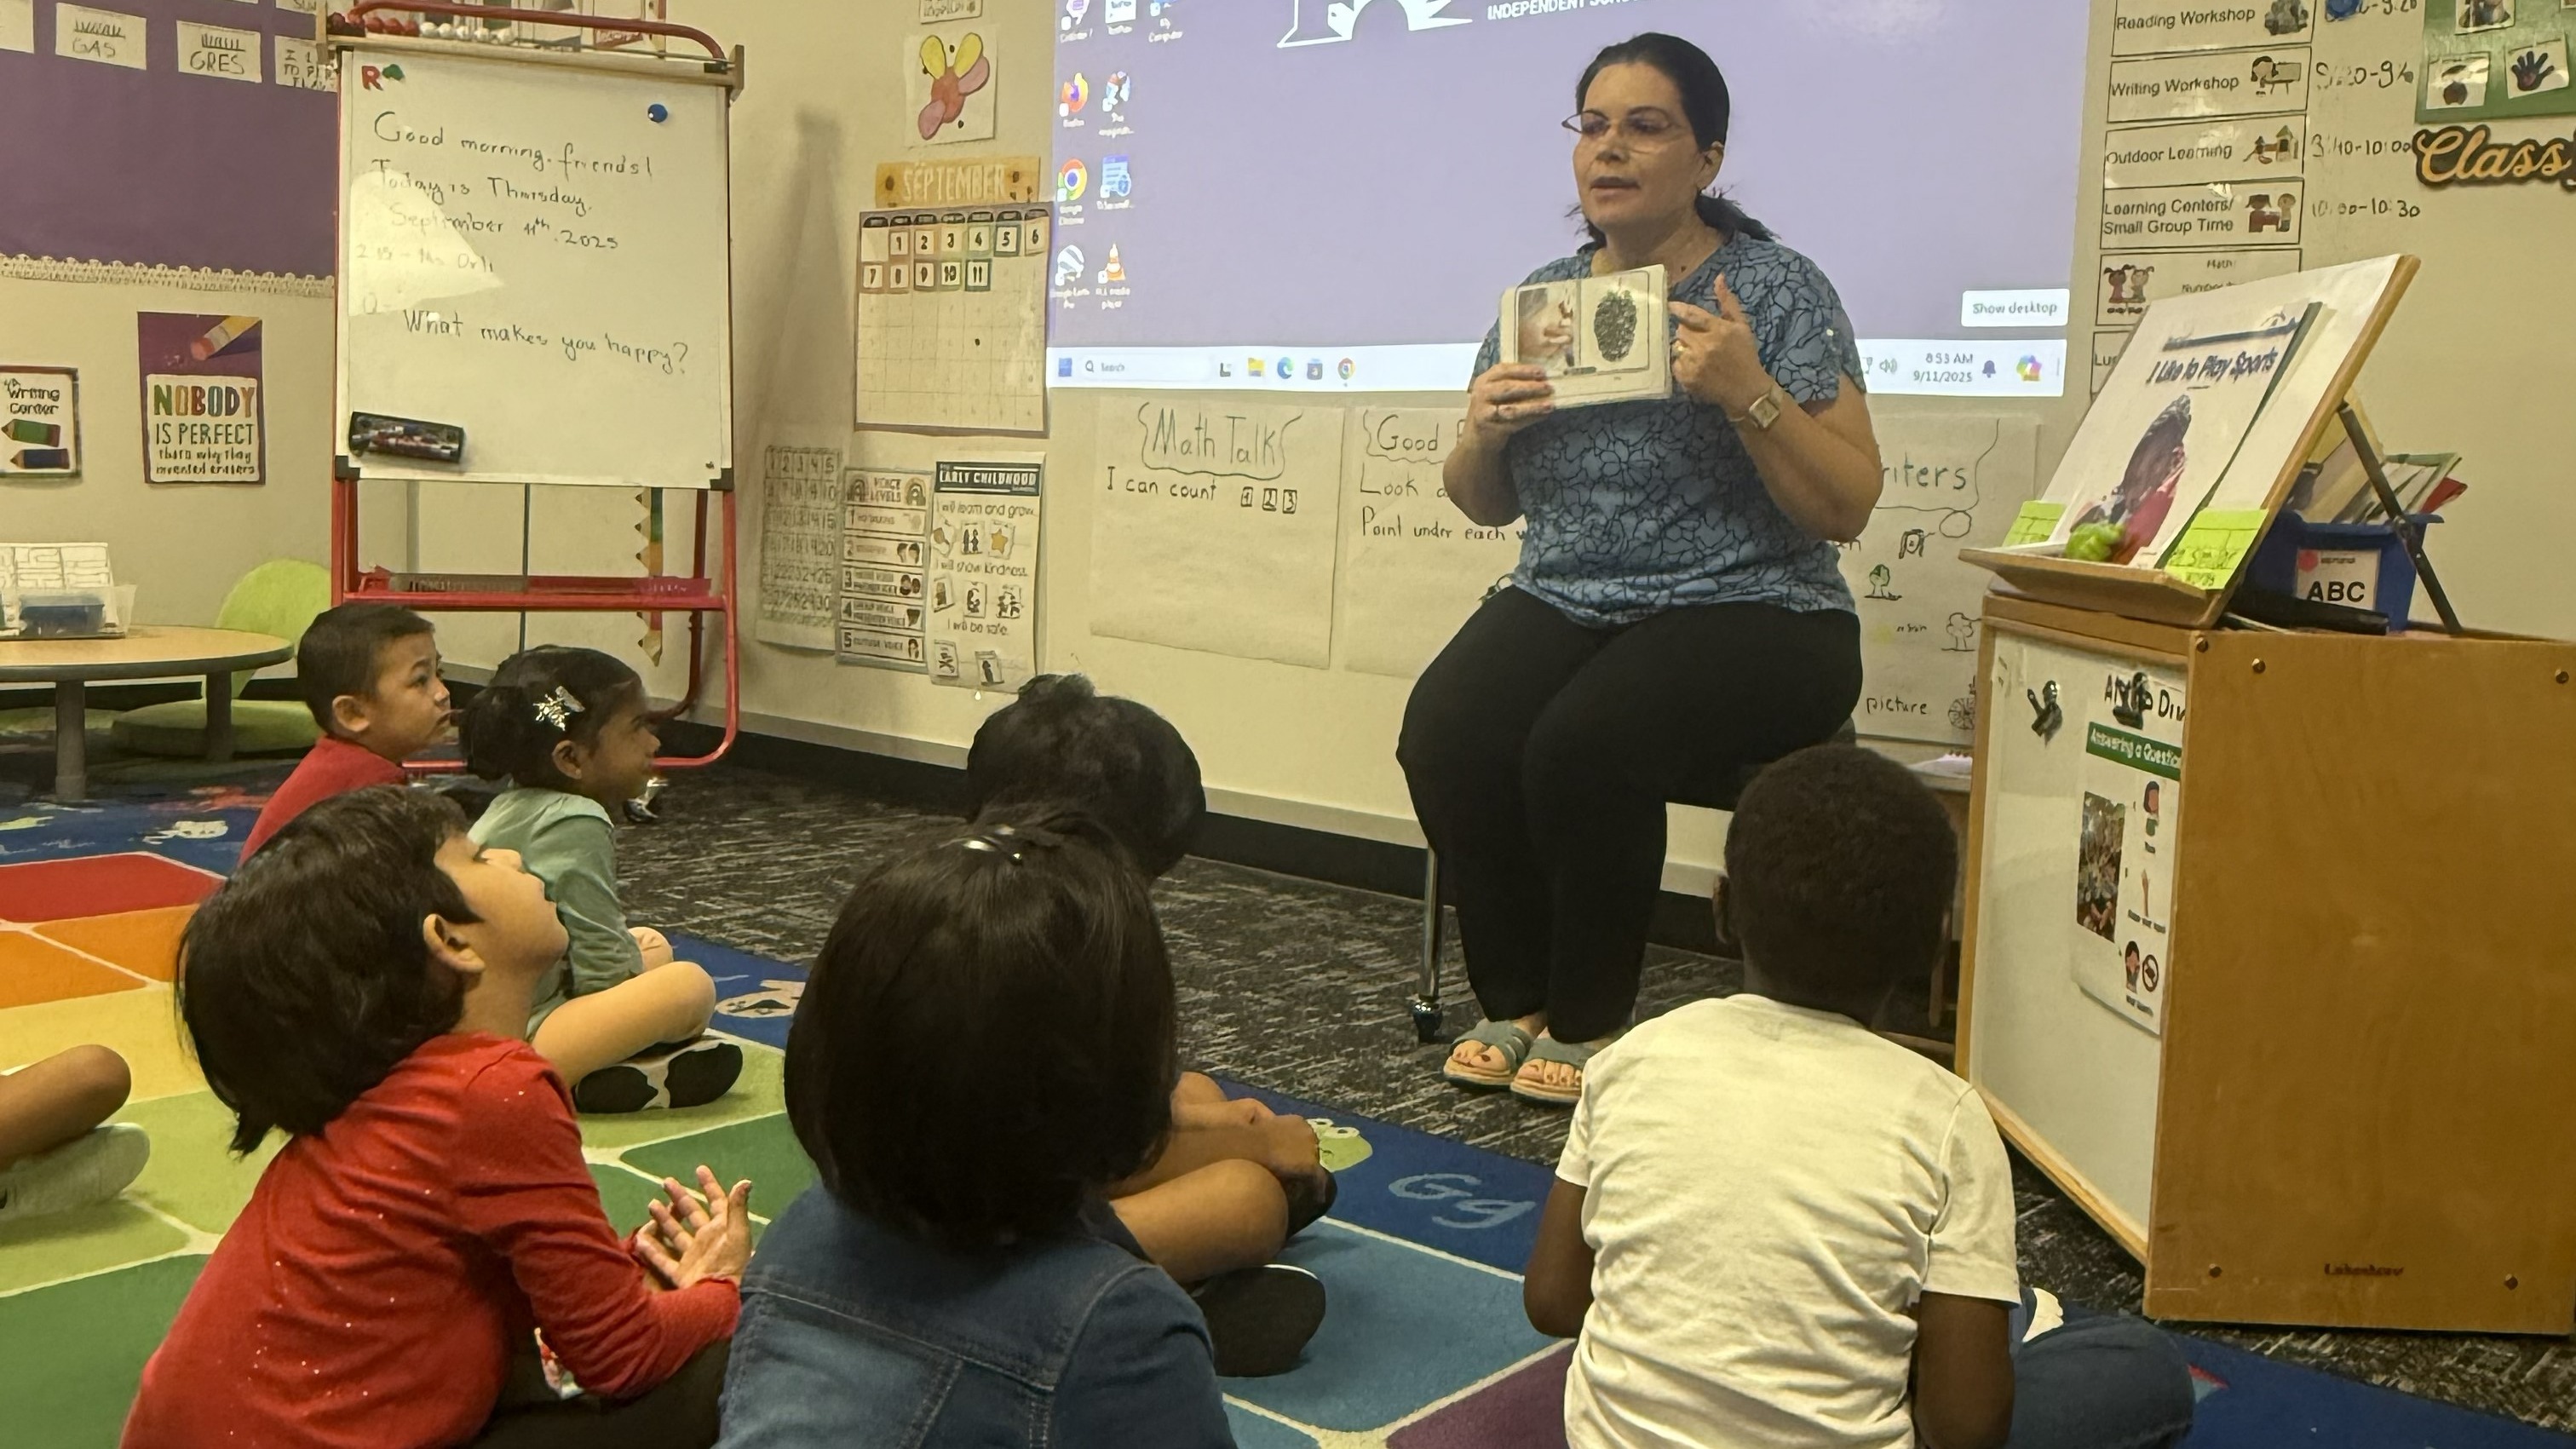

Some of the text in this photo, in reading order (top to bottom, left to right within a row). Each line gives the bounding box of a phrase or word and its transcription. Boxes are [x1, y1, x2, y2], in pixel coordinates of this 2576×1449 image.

[2116, 8, 2256, 31] Reading Workshop
[72, 37, 116, 58] GAS
[189, 51, 245, 75] GRES
[2110, 77, 2240, 98] Writing Workshop
[374, 111, 445, 147] Good
[2106, 145, 2233, 165] Outdoor Learning
[2416, 129, 2573, 182] Class
[902, 164, 1006, 202] SEPTEMBER
[2104, 200, 2166, 217] Learning
[2103, 218, 2234, 236] Small Group Time
[896, 228, 1039, 251] 1 2 3 4 5 6
[870, 267, 877, 285] 7
[921, 266, 929, 283] 9
[944, 265, 957, 283] 10
[972, 265, 983, 284] 11
[1972, 302, 2058, 317] Show desktop
[403, 309, 689, 375] What makes you happy?
[1953, 352, 1974, 365] AM
[1913, 371, 1974, 383] 9/11/2025
[153, 384, 256, 418] NOBODY
[156, 423, 255, 446] IS PERFECT
[1153, 408, 1277, 468] Math Talk
[1377, 414, 1440, 451] Good
[940, 470, 1037, 486] EARLY CHILDHOOD
[1360, 462, 1419, 497] Look
[1880, 450, 1969, 491] riters
[1107, 466, 1116, 491] I
[1125, 479, 1159, 495] can
[1170, 478, 1217, 501] count
[985, 504, 1005, 516] and
[1362, 505, 1401, 538] Point
[1413, 520, 1452, 538] under
[1464, 527, 1506, 542] each
[844, 570, 852, 588] 3
[2307, 580, 2366, 603] ABC
[843, 631, 853, 648] 5
[1866, 696, 1929, 717] picture
[1388, 1172, 1537, 1229] Gg
